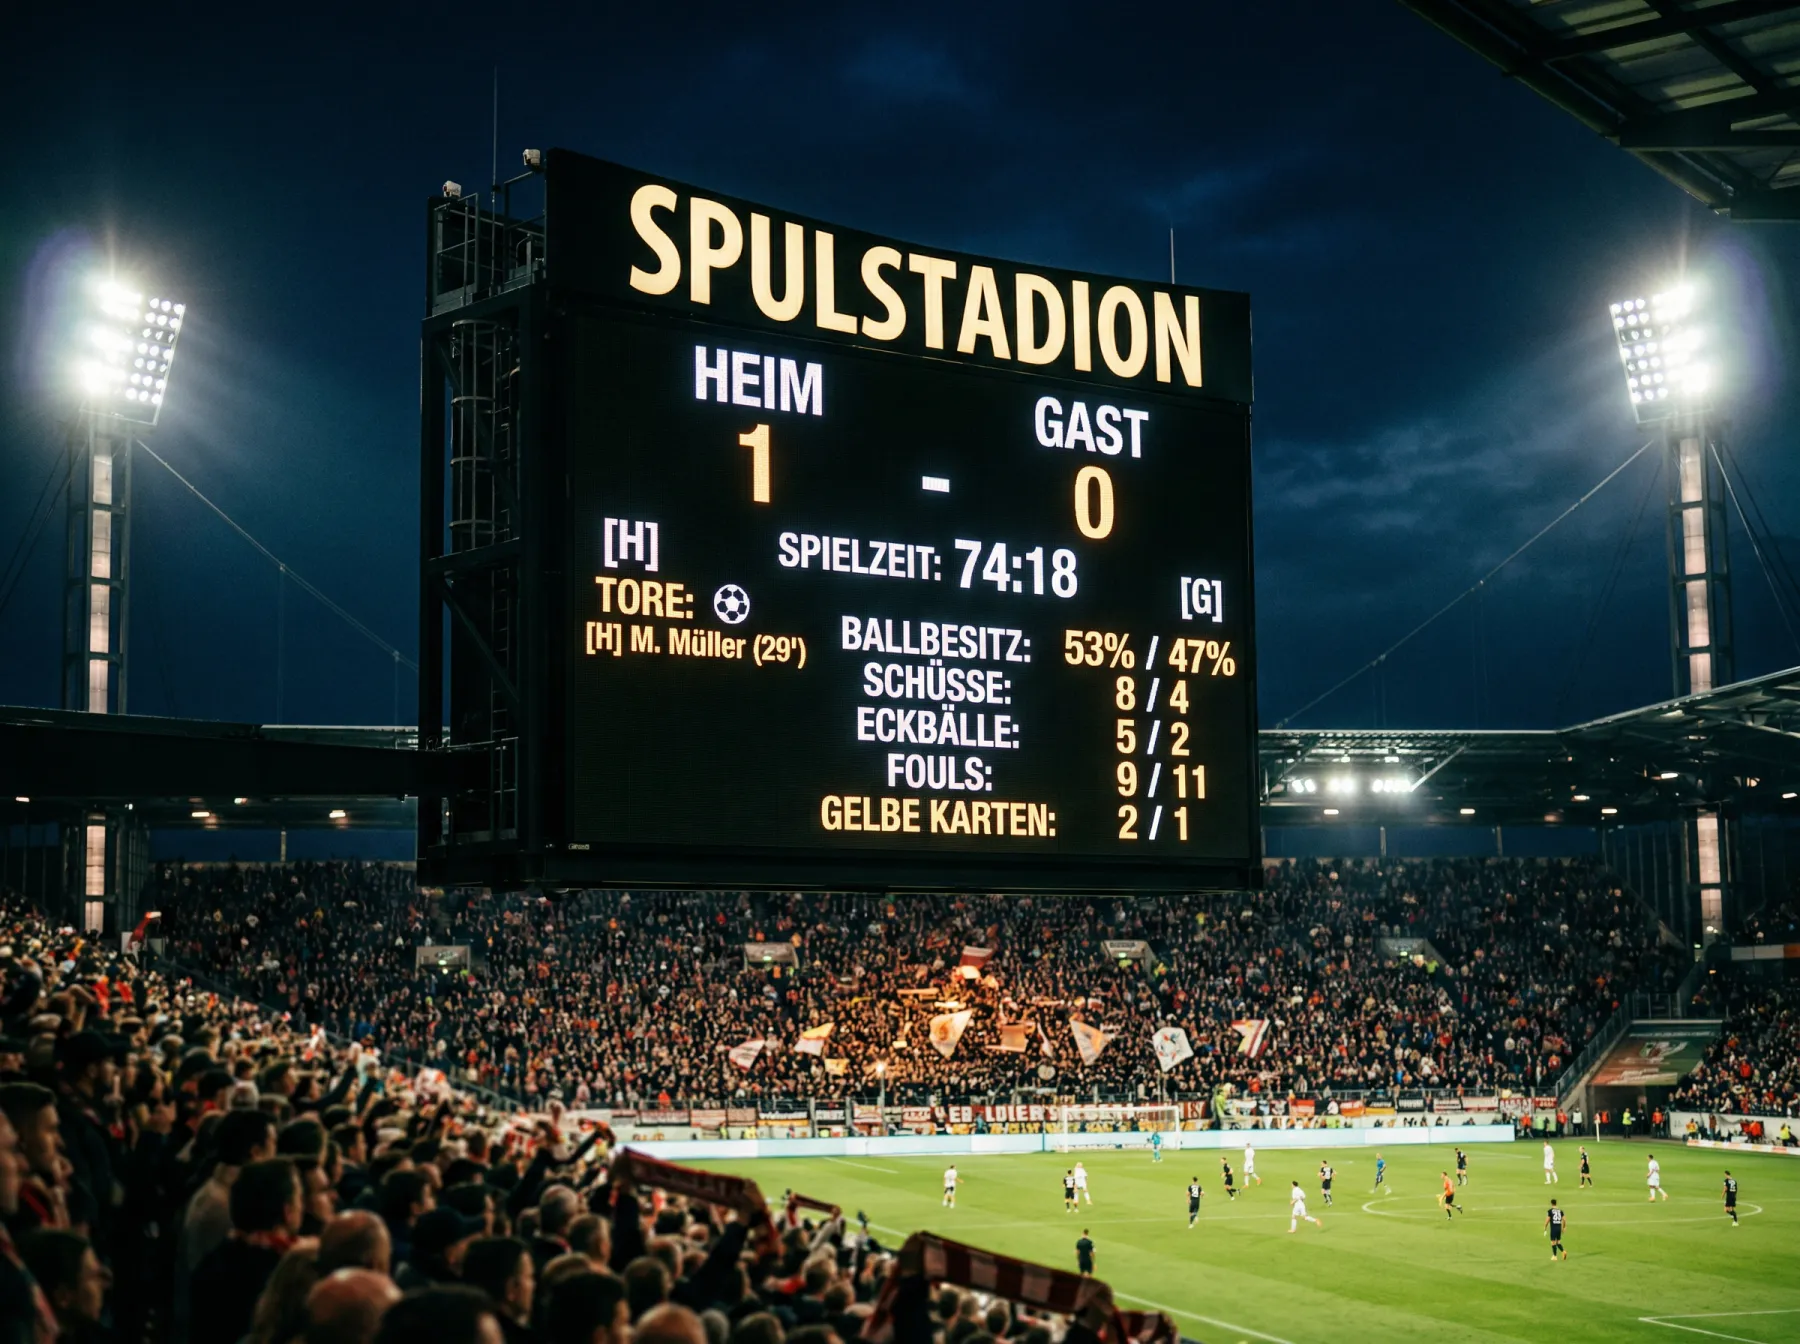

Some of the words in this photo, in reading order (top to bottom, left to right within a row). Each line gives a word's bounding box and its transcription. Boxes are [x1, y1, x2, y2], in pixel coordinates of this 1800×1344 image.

[629, 184, 1203, 388] SPULSTADION
[695, 345, 822, 416] HEIM
[1035, 396, 1149, 458] GAST
[739, 424, 770, 503] 1
[1075, 466, 1114, 539] 0
[604, 518, 658, 572] [H]
[778, 532, 941, 581] SPIELZEIT:
[955, 539, 1077, 598] 74:18
[595, 576, 693, 619] TORE:
[1181, 577, 1222, 623] [G]
[586, 621, 622, 656] [H]
[631, 625, 660, 653] M.
[669, 628, 746, 659] Müller
[753, 634, 806, 669] (29')
[842, 616, 1030, 662] BALLBESITZ:
[1065, 630, 1135, 669] 53%
[1146, 636, 1159, 670] /
[1169, 638, 1235, 676] 47%
[863, 659, 1011, 704] SCHÜSSE:
[1116, 676, 1135, 710] 8
[1146, 678, 1160, 712] /
[1170, 680, 1189, 714] 4
[858, 703, 1019, 748] ECKBÄLLE:
[1117, 719, 1136, 754] 5
[1147, 720, 1160, 754] /
[1171, 722, 1189, 756] 2
[888, 753, 992, 791] FOULS:
[1117, 761, 1137, 796] 9
[1148, 763, 1161, 797] /
[1173, 764, 1205, 799] 11
[821, 795, 920, 832] GELBE
[930, 799, 1055, 836] KARTEN:
[1118, 805, 1137, 839] 2
[1149, 805, 1162, 840] /
[1174, 807, 1187, 840] 1
